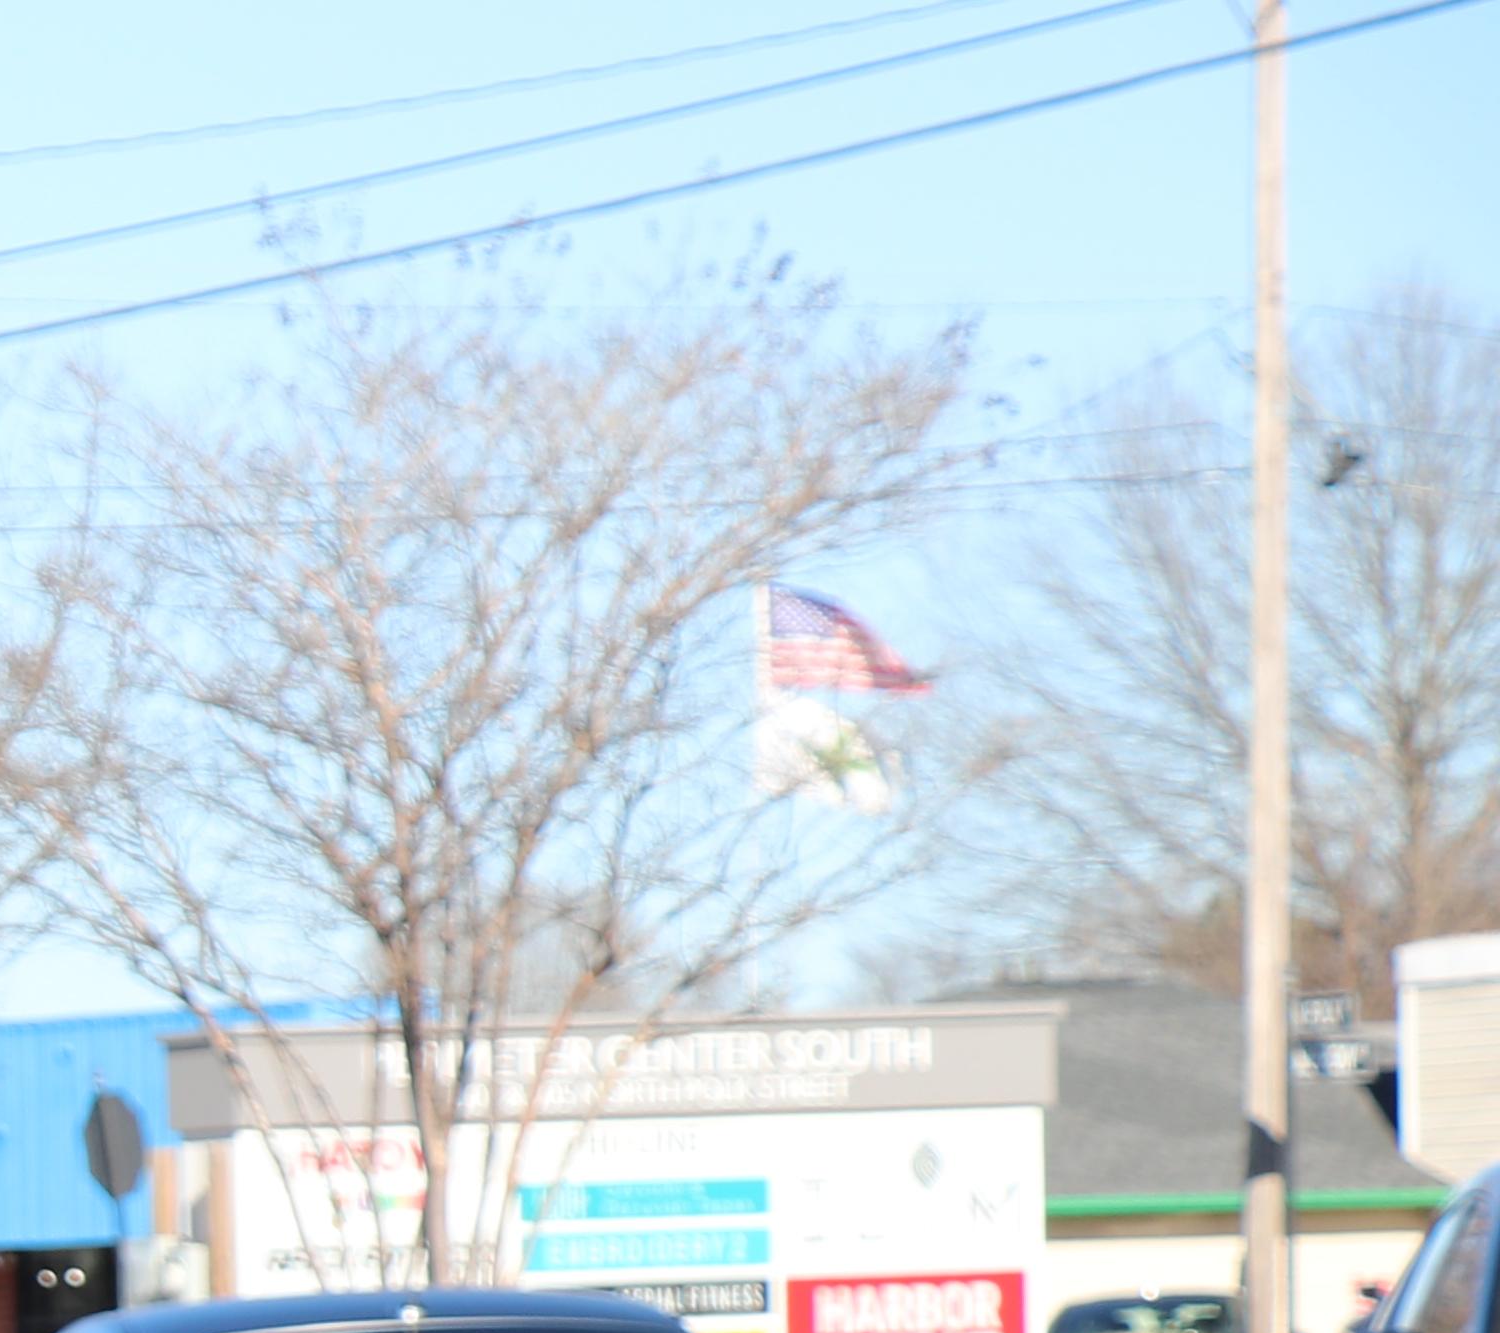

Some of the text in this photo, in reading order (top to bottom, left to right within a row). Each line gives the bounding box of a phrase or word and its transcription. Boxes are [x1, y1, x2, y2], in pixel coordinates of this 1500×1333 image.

[597, 1031, 775, 1073] CENTER
[778, 1026, 934, 1073] SOUTH
[759, 1072, 850, 1099] STREET
[689, 1283, 765, 1310] FITNESS
[813, 1281, 1004, 1332] HARBOR
